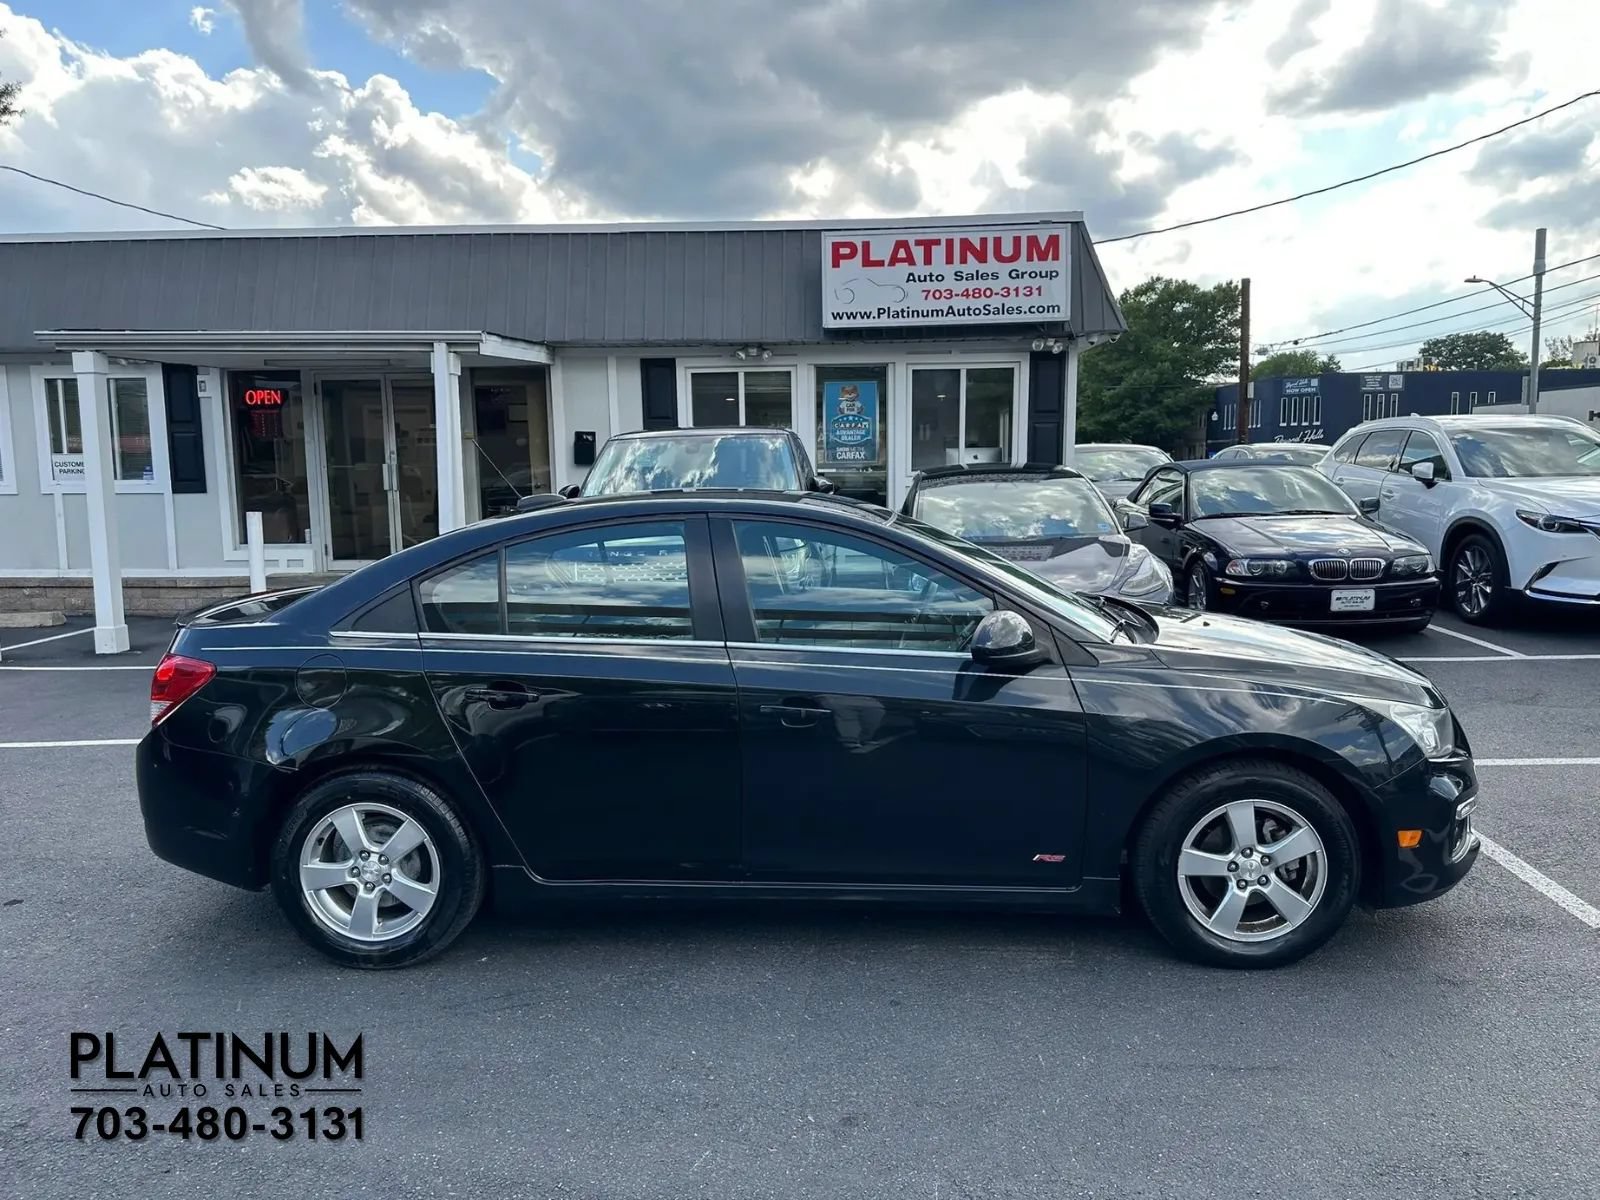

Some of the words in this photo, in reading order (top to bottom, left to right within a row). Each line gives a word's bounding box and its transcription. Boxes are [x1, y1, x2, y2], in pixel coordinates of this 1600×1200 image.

[831, 235, 1060, 269] PLATINUM
[905, 272, 945, 284] Auto
[953, 270, 1000, 282] Sales
[1008, 268, 1060, 281] Group
[921, 286, 1043, 301] 703-480-3131
[831, 303, 1061, 321] www.PlatinumAutoSales.com
[245, 390, 281, 405] OPEN
[836, 451, 865, 460] CARFAX
